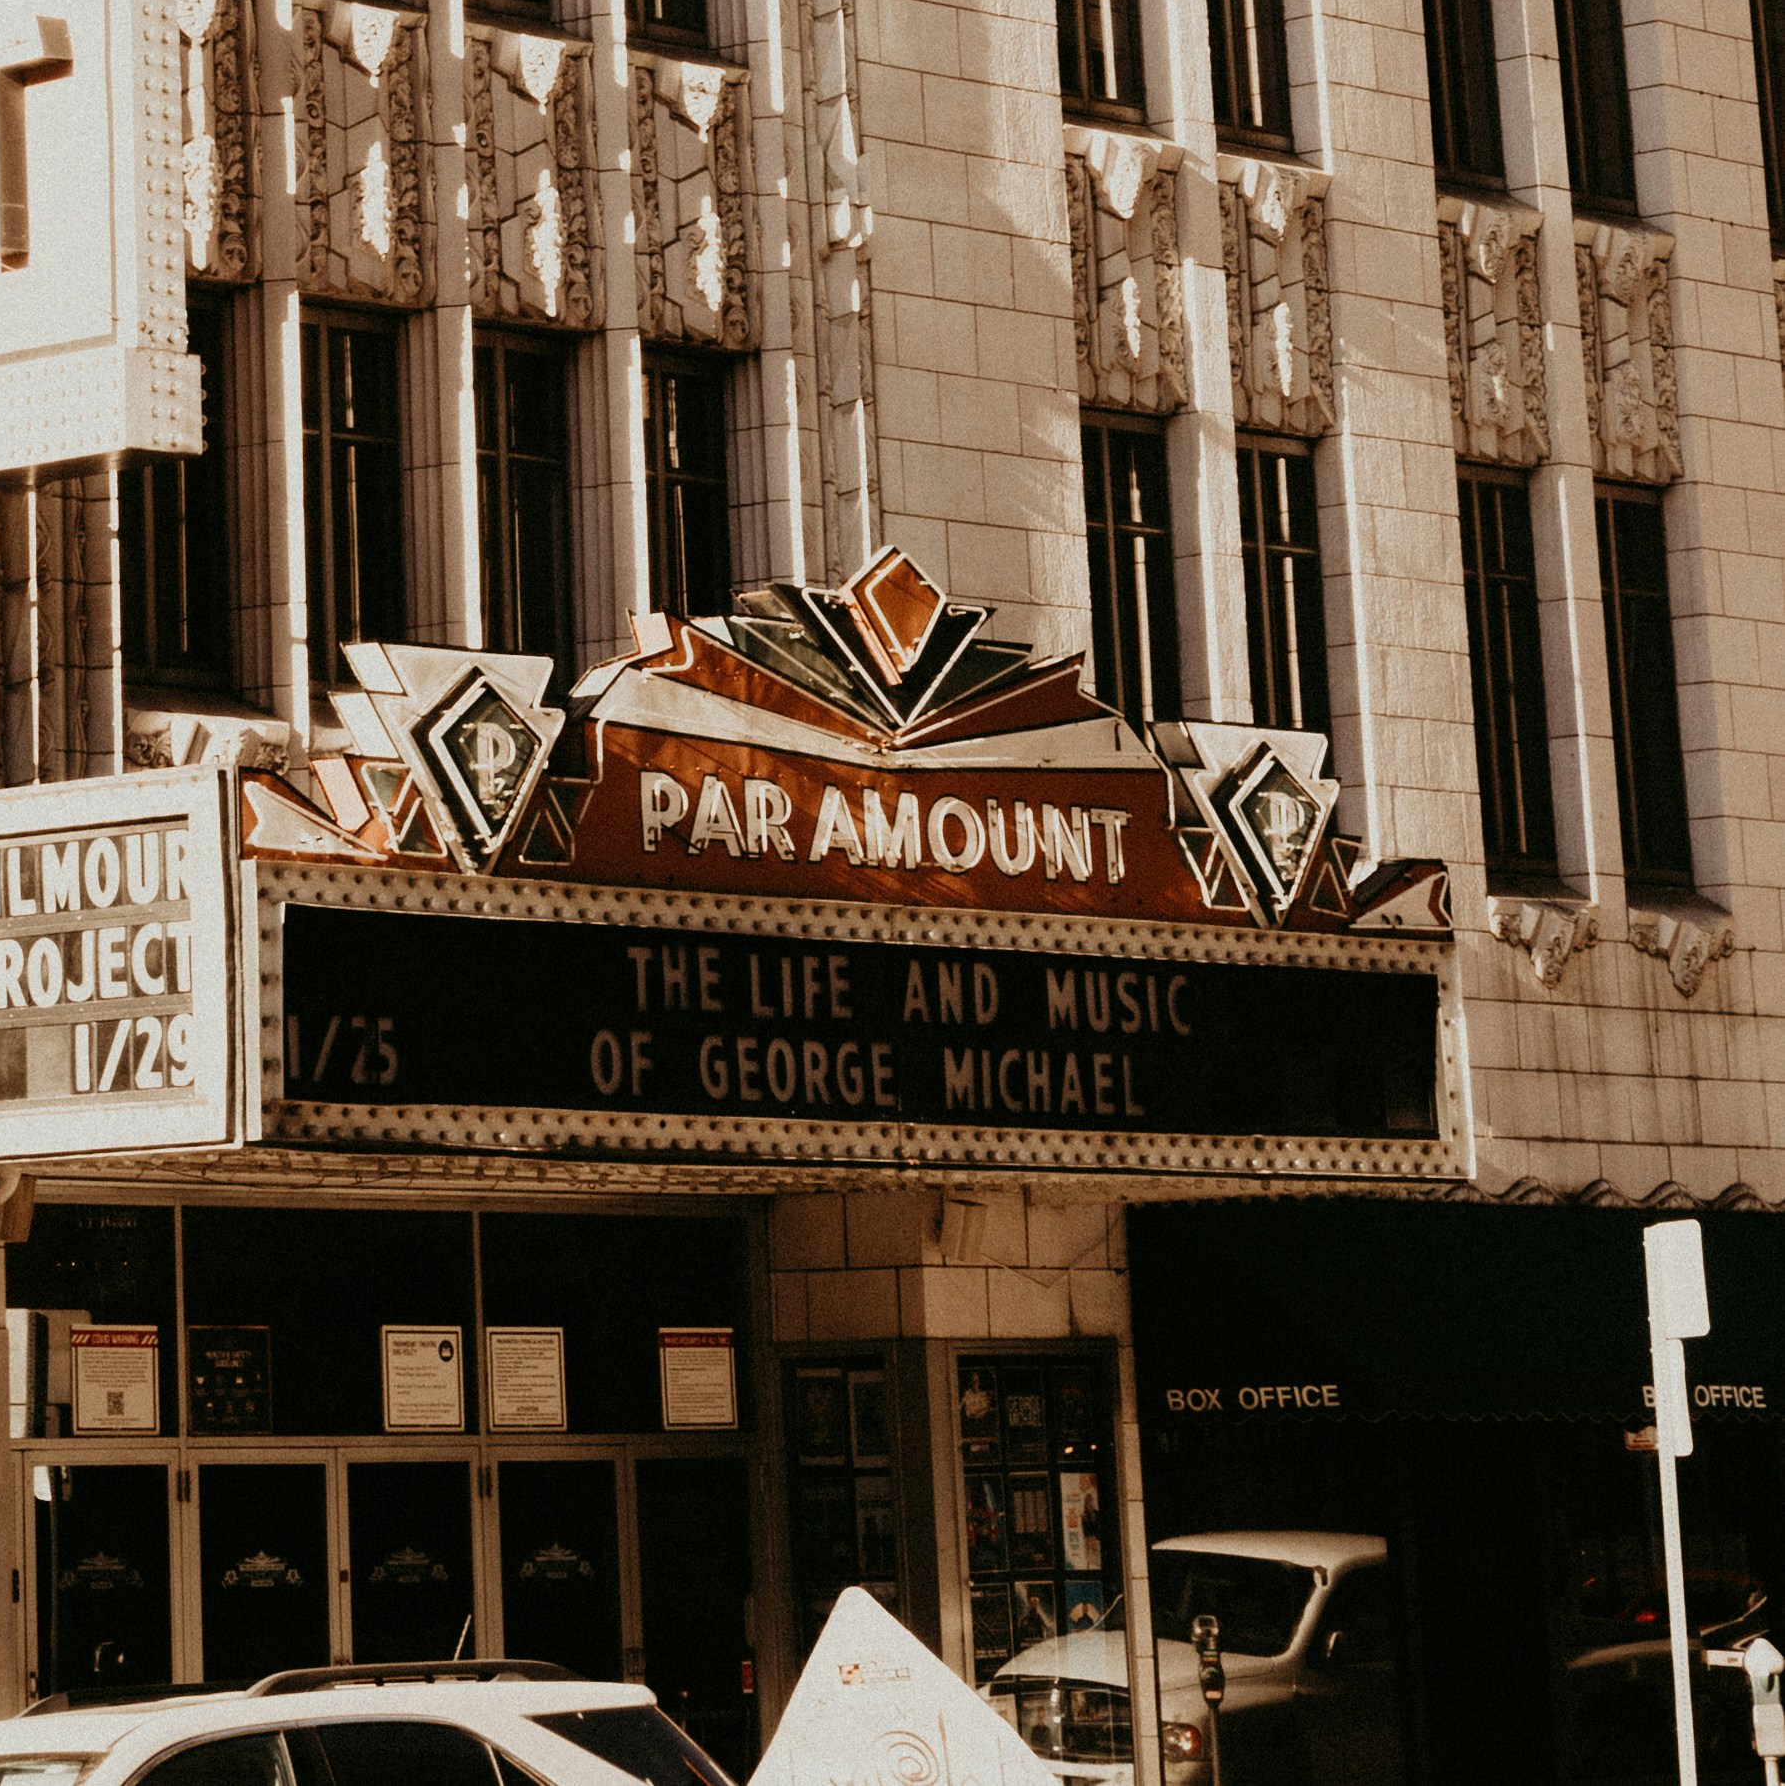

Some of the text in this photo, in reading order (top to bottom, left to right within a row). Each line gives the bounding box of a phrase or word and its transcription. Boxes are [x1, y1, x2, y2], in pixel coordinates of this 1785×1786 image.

[639, 770, 1131, 885] PARAMOUNT
[627, 945, 1191, 1036] THE LIFE AND MUSIC
[74, 1013, 194, 1093] 1/29
[287, 1014, 399, 1086] 1/25
[590, 1029, 1146, 1117] OF GEORGE MICHAEL
[1166, 1384, 1341, 1411] BOX OFFICE
[1694, 1384, 1767, 1408] OFFICE
